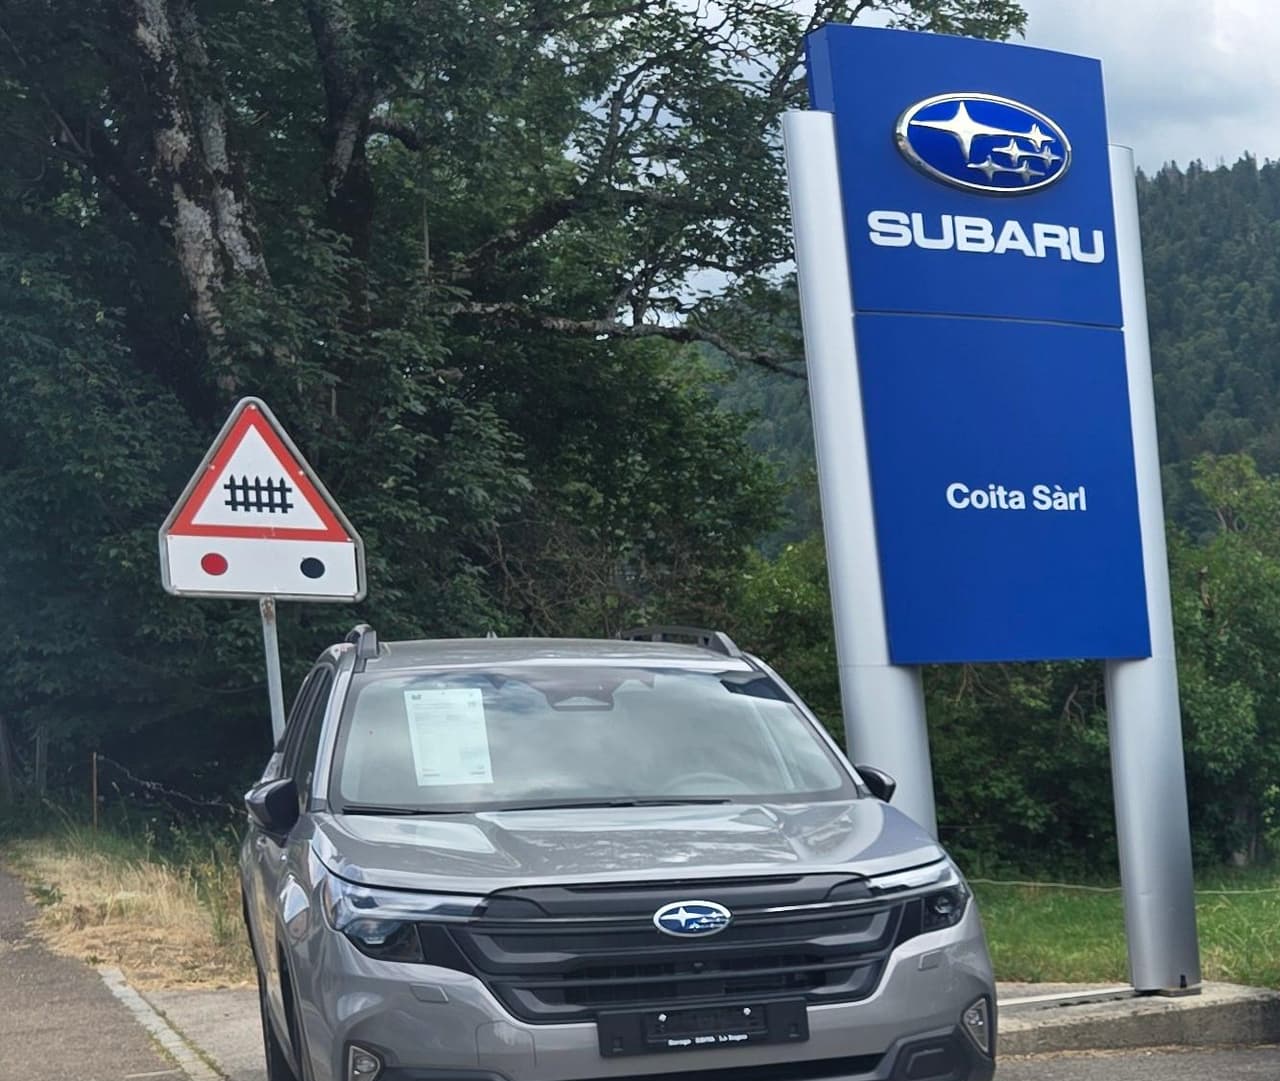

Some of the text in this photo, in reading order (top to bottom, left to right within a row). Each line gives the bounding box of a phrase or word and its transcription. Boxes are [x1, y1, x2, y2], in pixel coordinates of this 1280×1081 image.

[867, 210, 1105, 264] SUBARU
[946, 481, 1087, 512] Coita Sàrl
